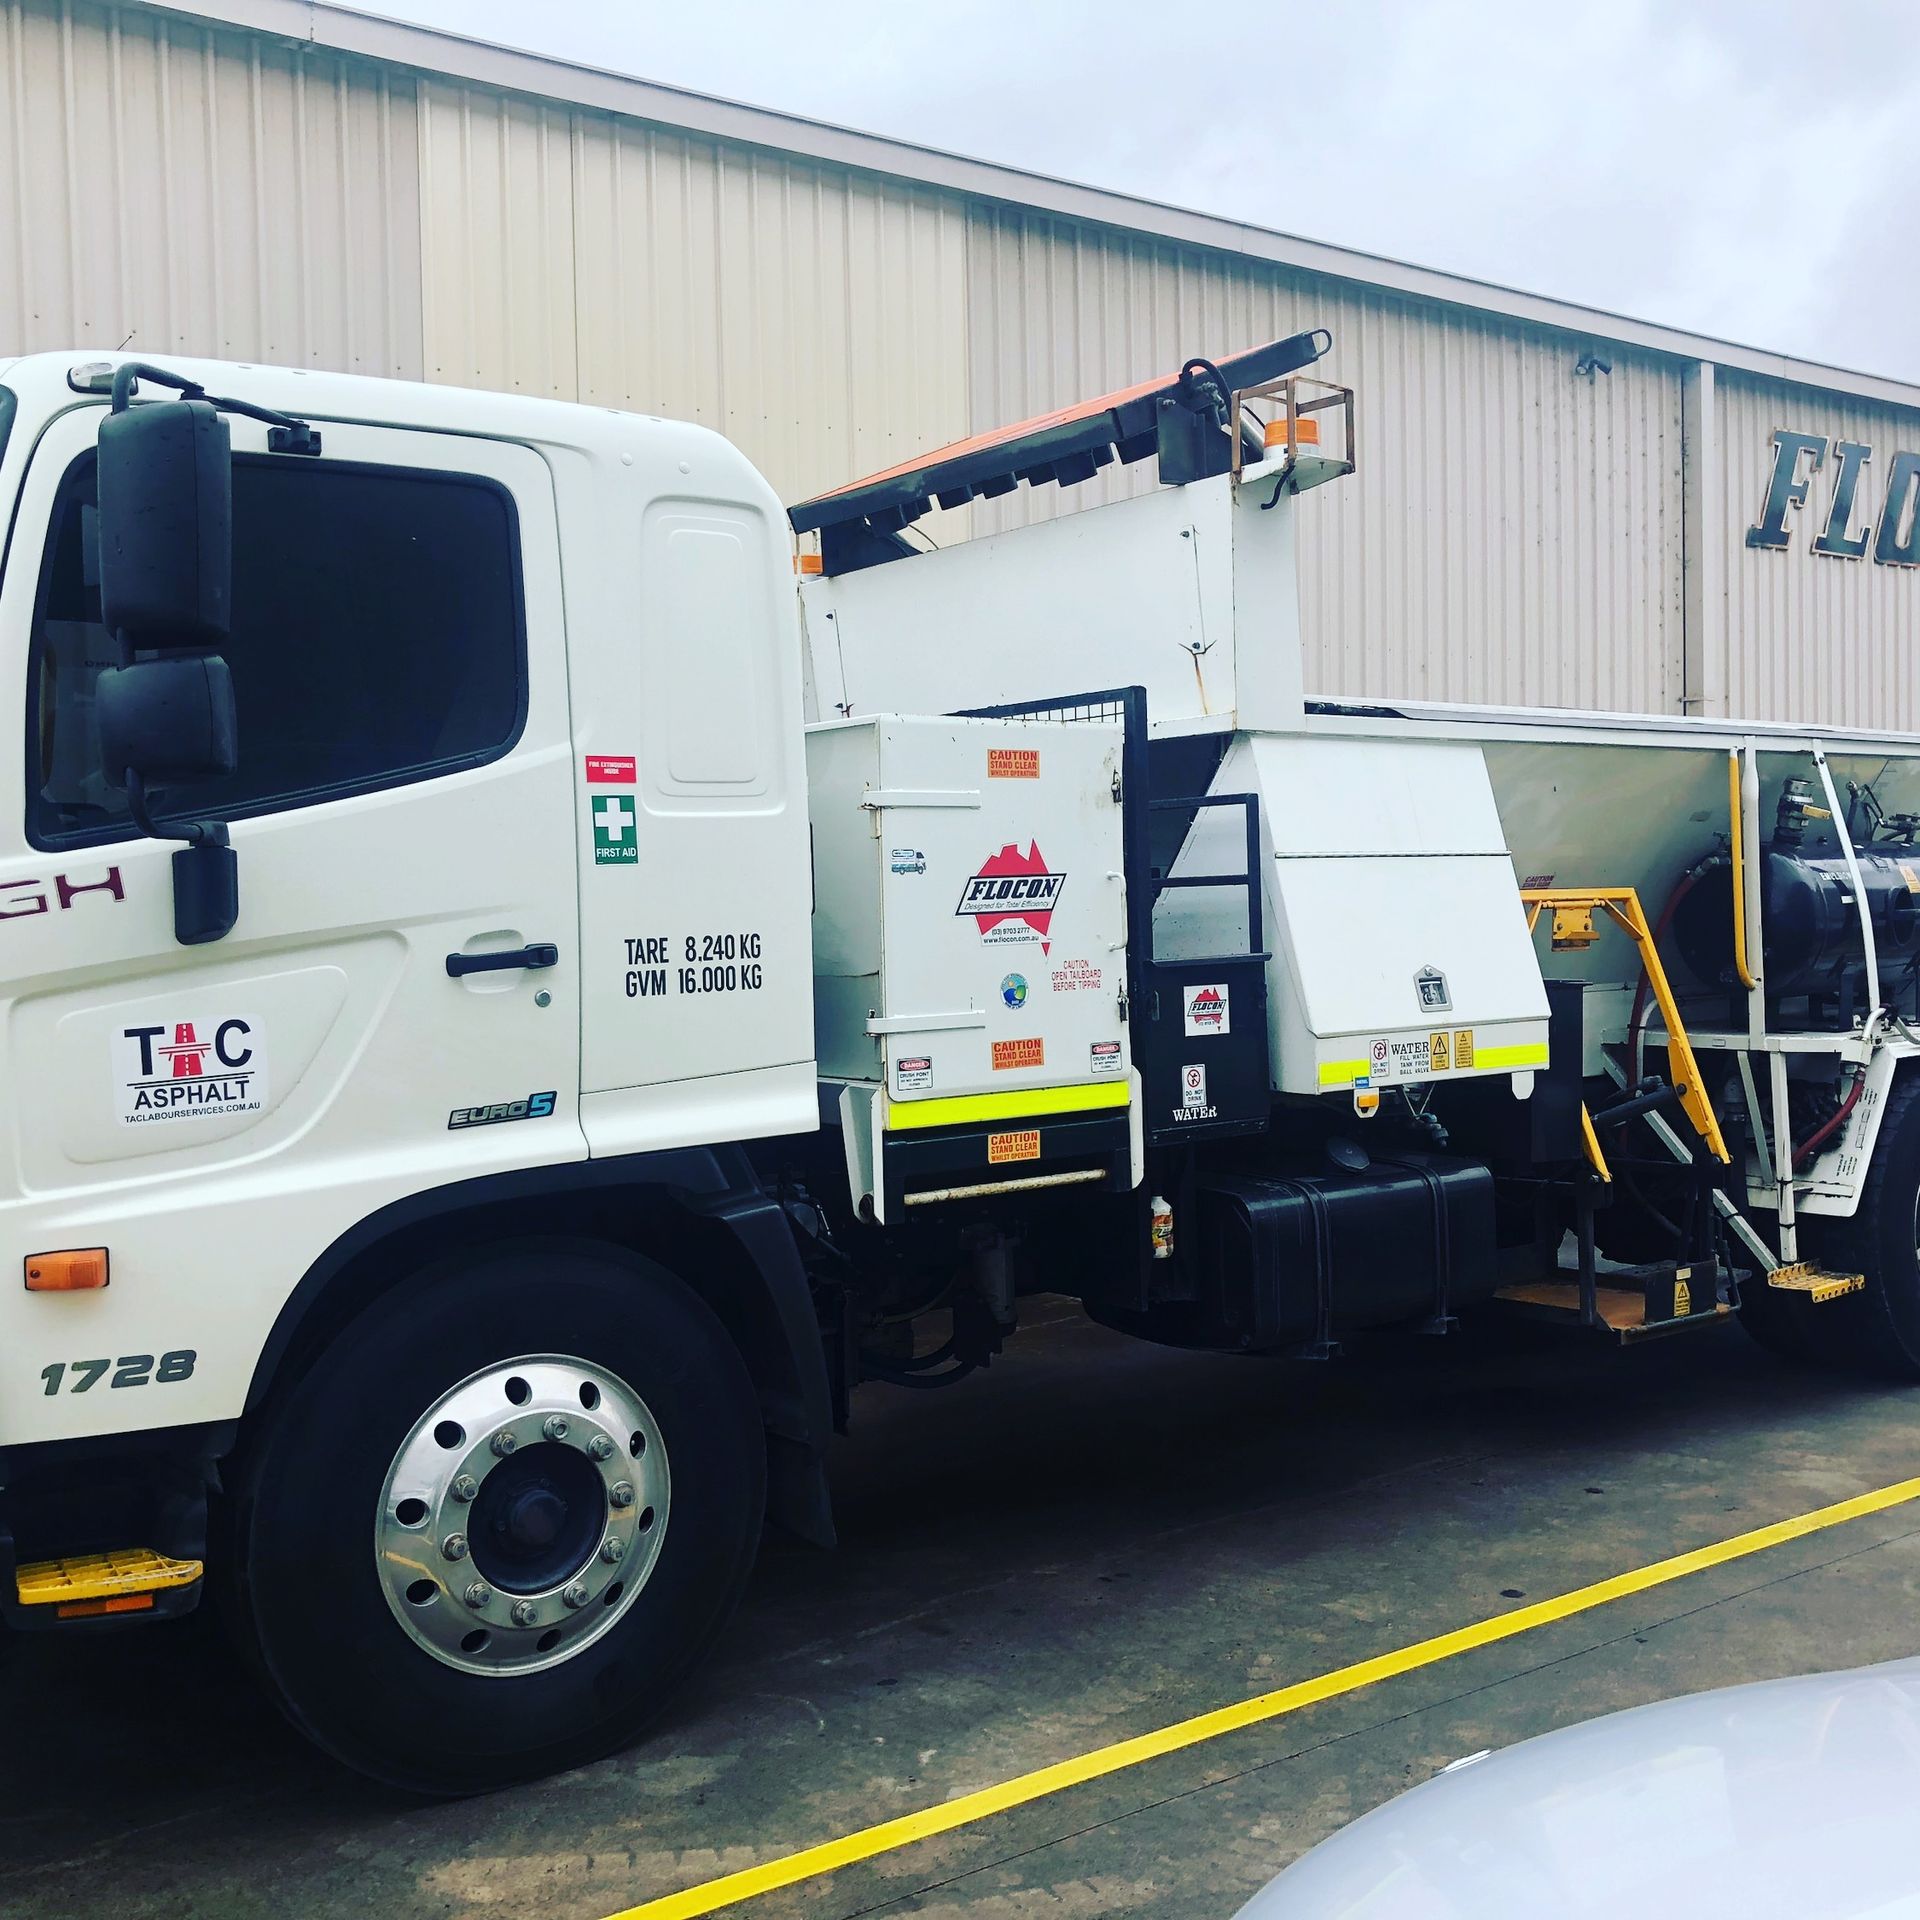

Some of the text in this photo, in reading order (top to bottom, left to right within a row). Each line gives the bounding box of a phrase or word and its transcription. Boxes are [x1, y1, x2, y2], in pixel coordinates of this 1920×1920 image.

[990, 750, 1037, 761] CAUTION
[600, 761, 634, 769] EXTINGUISHER
[990, 760, 1037, 770] STAND CLEAR
[596, 847, 637, 858] FIRST AID
[0, 866, 125, 920] GH
[967, 879, 1059, 901] FLOCON
[964, 902, 995, 912] Designed
[995, 901, 1005, 909] for
[1021, 899, 1049, 909] Efficiency
[992, 926, 1030, 936] (03) 9703 2777
[983, 935, 1039, 944] www.flocon.com.au
[624, 933, 761, 965] TARE 8.240 KG
[1063, 960, 1089, 970] CAUTION
[625, 964, 762, 998] GVM 16.000 KG
[1051, 969, 1102, 981] OPEN TAILBOARD
[1053, 980, 1101, 992] BEFORE TIPPING
[1192, 1002, 1224, 1011] FLOCON
[993, 1039, 1041, 1052] CAUTION
[1390, 1041, 1429, 1055] WATER
[994, 1049, 1041, 1061] STAND CLEAR
[904, 1061, 925, 1069] DANGER
[134, 1080, 250, 1111] ASPHALT
[124, 1102, 261, 1123] TACLABOURSERVICES.COM.AU
[1172, 1105, 1218, 1122] WATER
[991, 1131, 1038, 1146] CAUTION
[991, 1142, 1038, 1154] STAND CLEAR
[991, 1151, 1038, 1162] WHILST OPERATING
[40, 1349, 197, 1396] 1728
